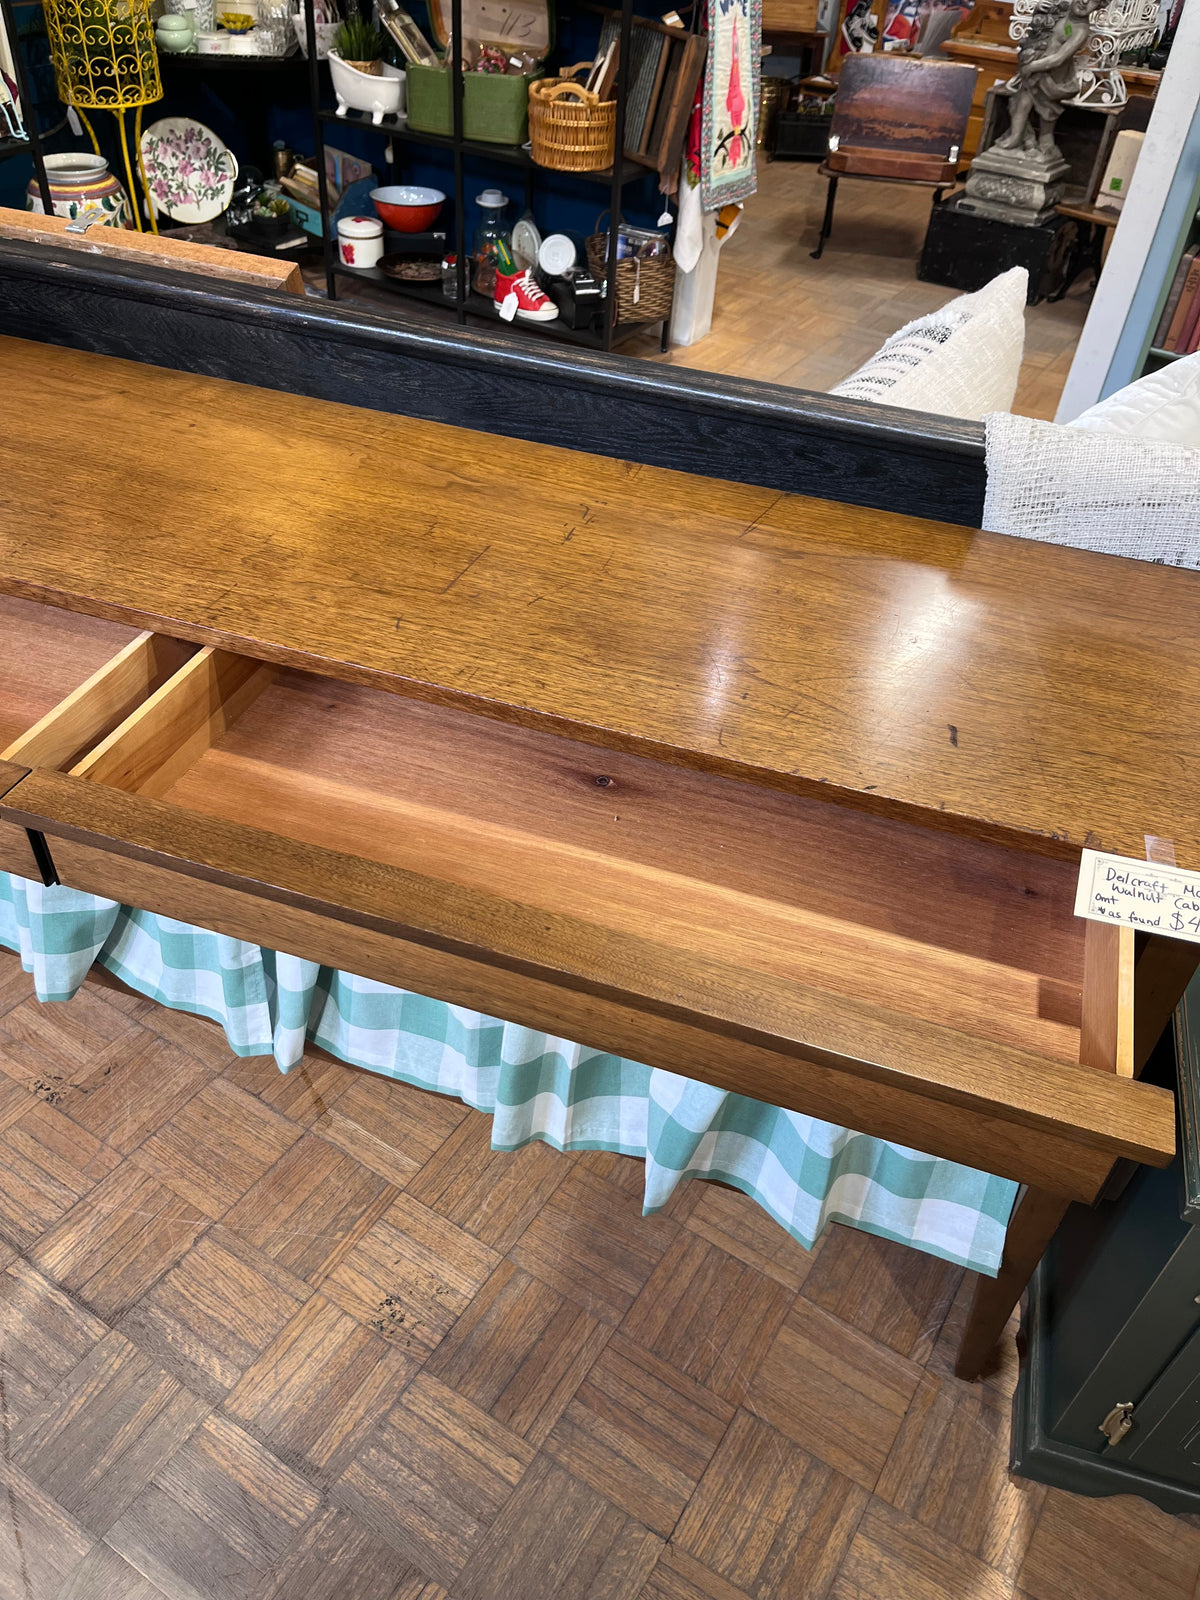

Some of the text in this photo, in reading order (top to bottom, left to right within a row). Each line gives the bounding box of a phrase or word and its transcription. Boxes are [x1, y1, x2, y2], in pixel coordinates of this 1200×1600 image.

[1173, 897, 1200, 912] Cab
[1108, 911, 1161, 926] as found
